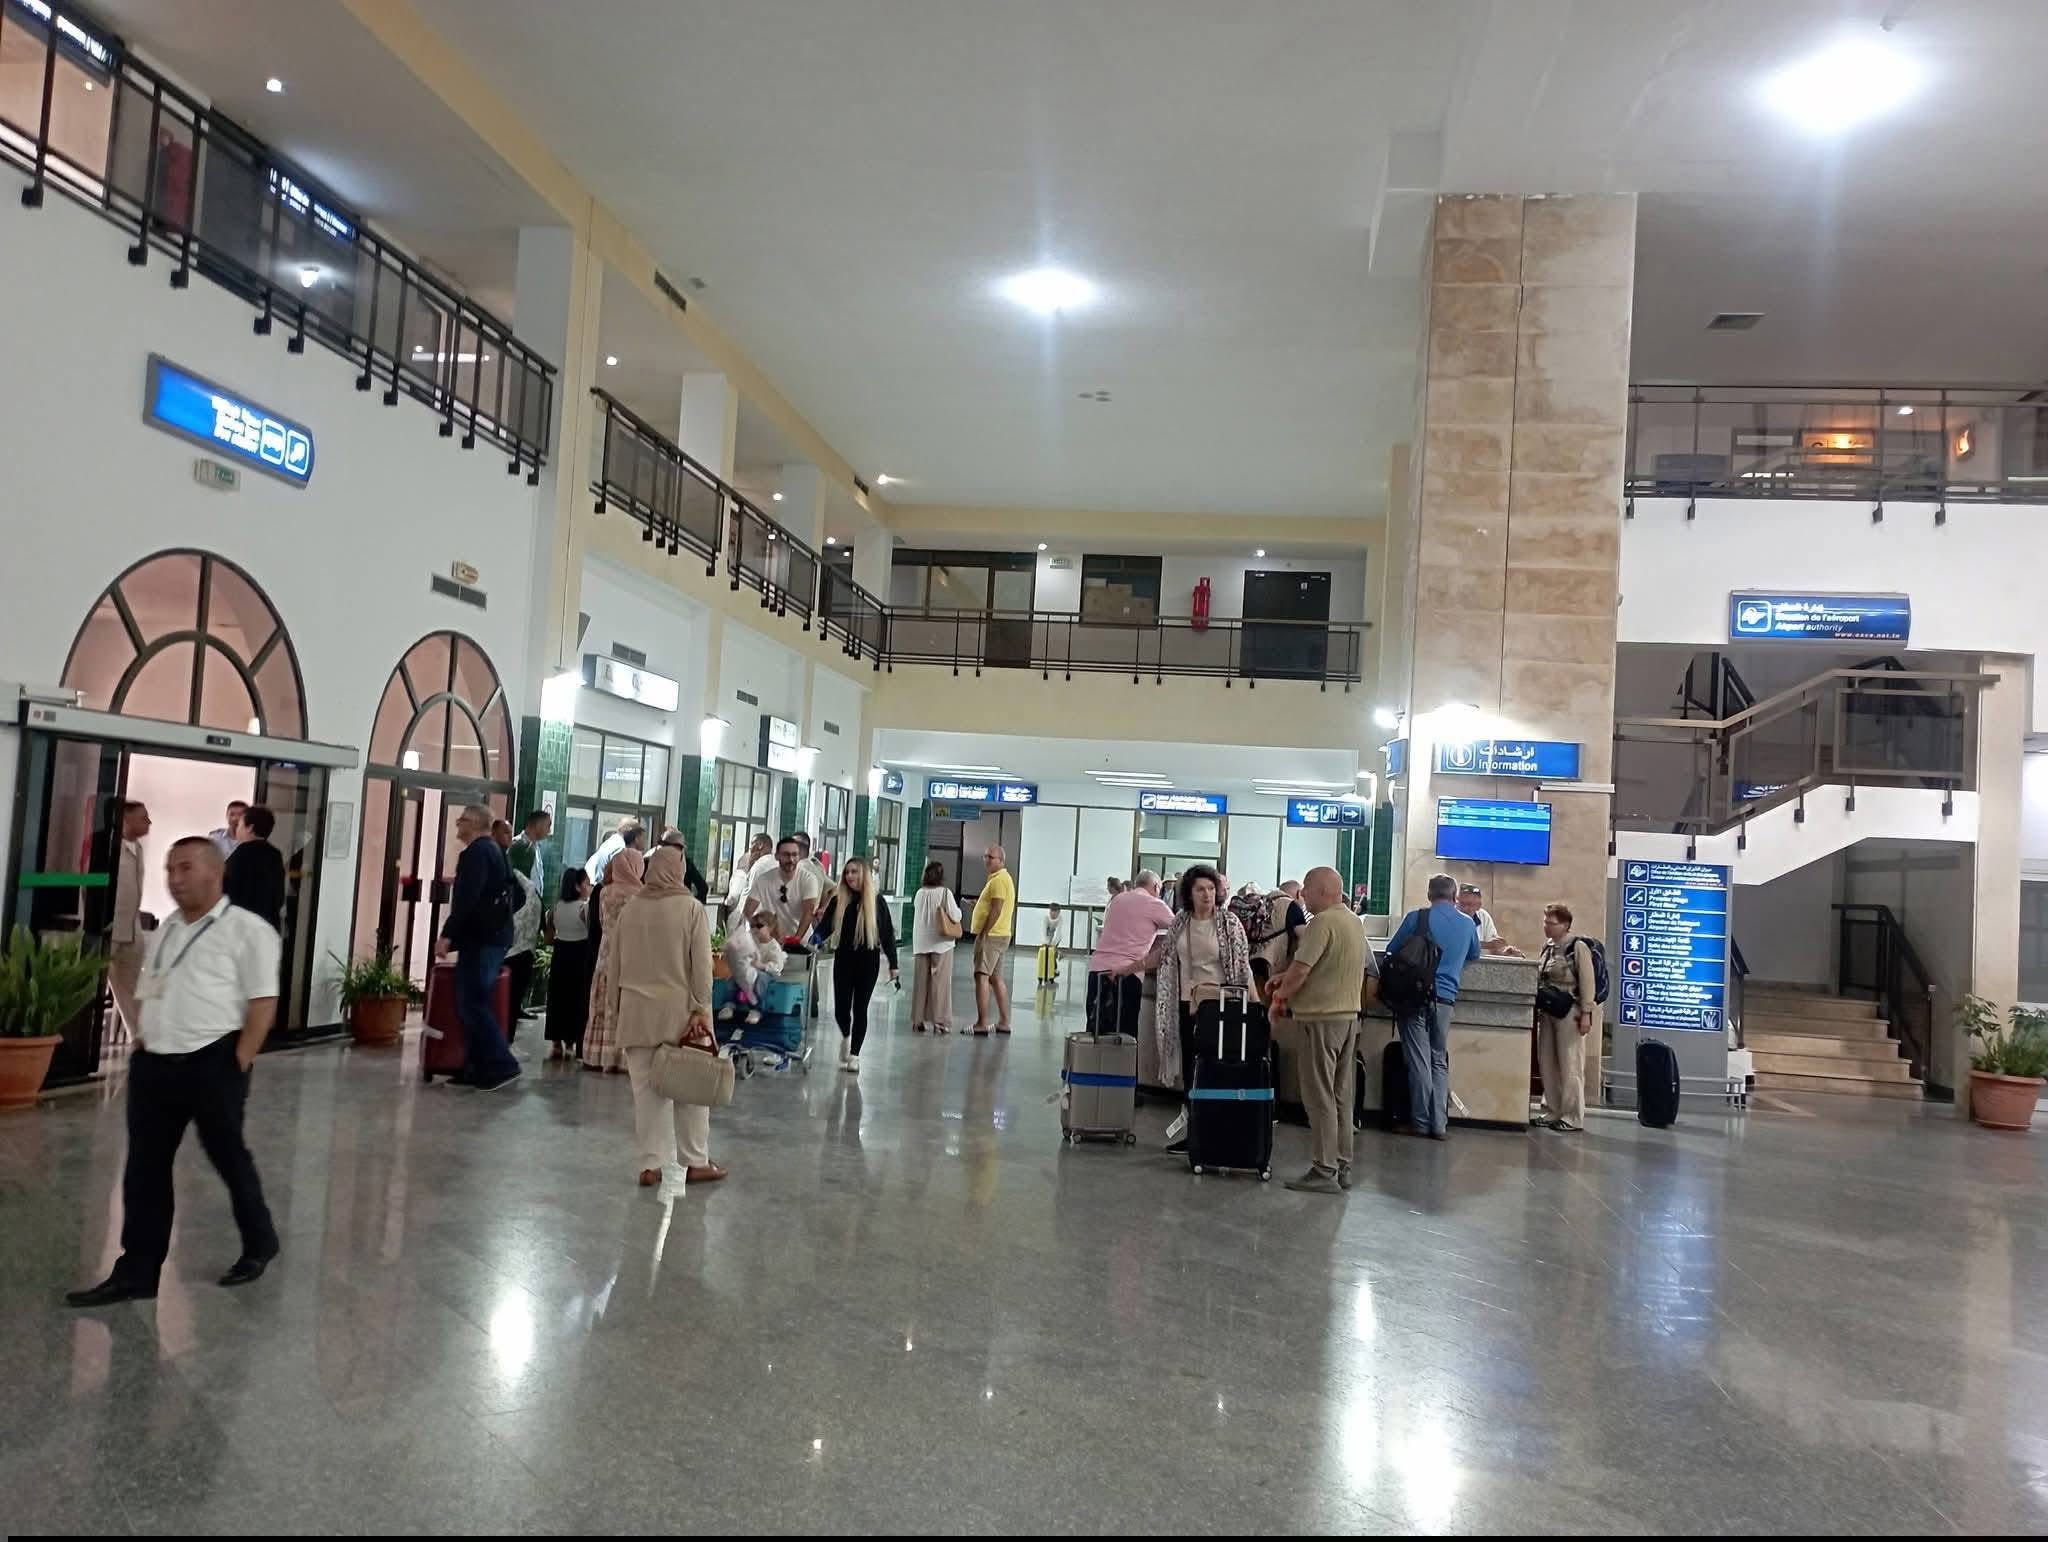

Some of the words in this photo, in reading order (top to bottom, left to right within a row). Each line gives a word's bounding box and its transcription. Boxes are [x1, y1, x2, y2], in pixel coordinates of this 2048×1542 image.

[1811, 614, 1822, 622] de
[1806, 623, 1843, 633] authority
[1479, 758, 1538, 772] Information
